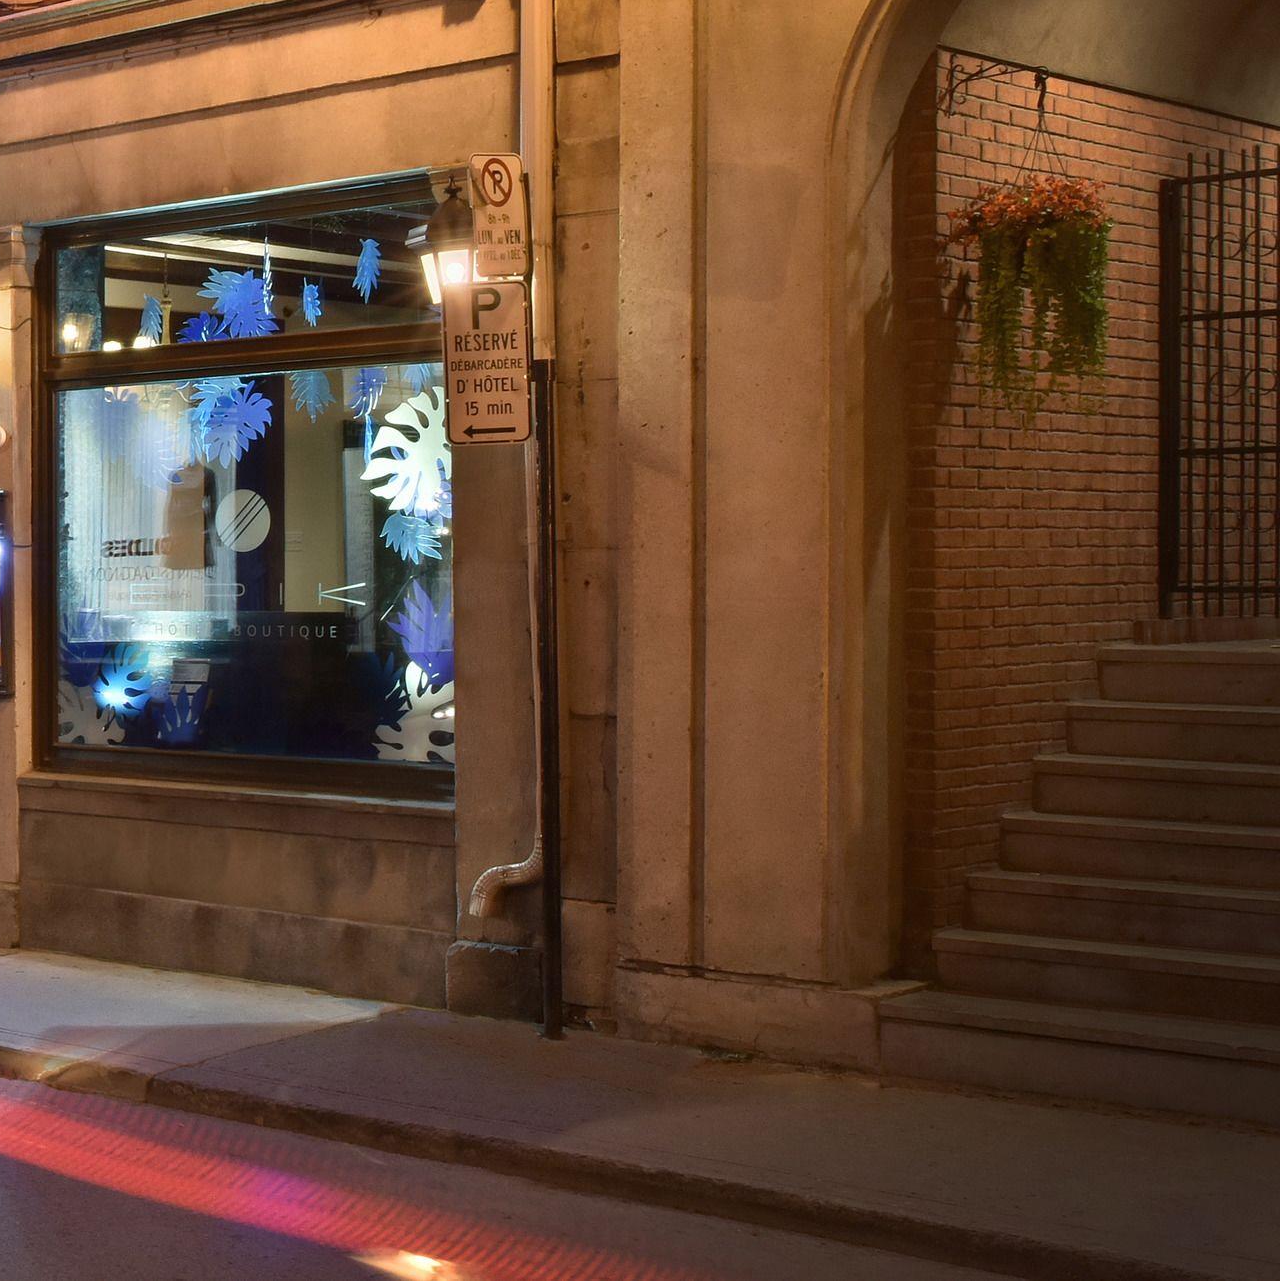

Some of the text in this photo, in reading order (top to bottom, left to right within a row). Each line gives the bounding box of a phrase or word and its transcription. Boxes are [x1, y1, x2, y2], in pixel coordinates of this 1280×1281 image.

[471, 287, 502, 330] P
[454, 329, 518, 352] RÉSERVÉ
[450, 357, 524, 372] DÉBARCADÈRE
[473, 375, 520, 393] HÔTEL
[465, 401, 479, 416] 15
[234, 624, 338, 640] BOUTIQUE
